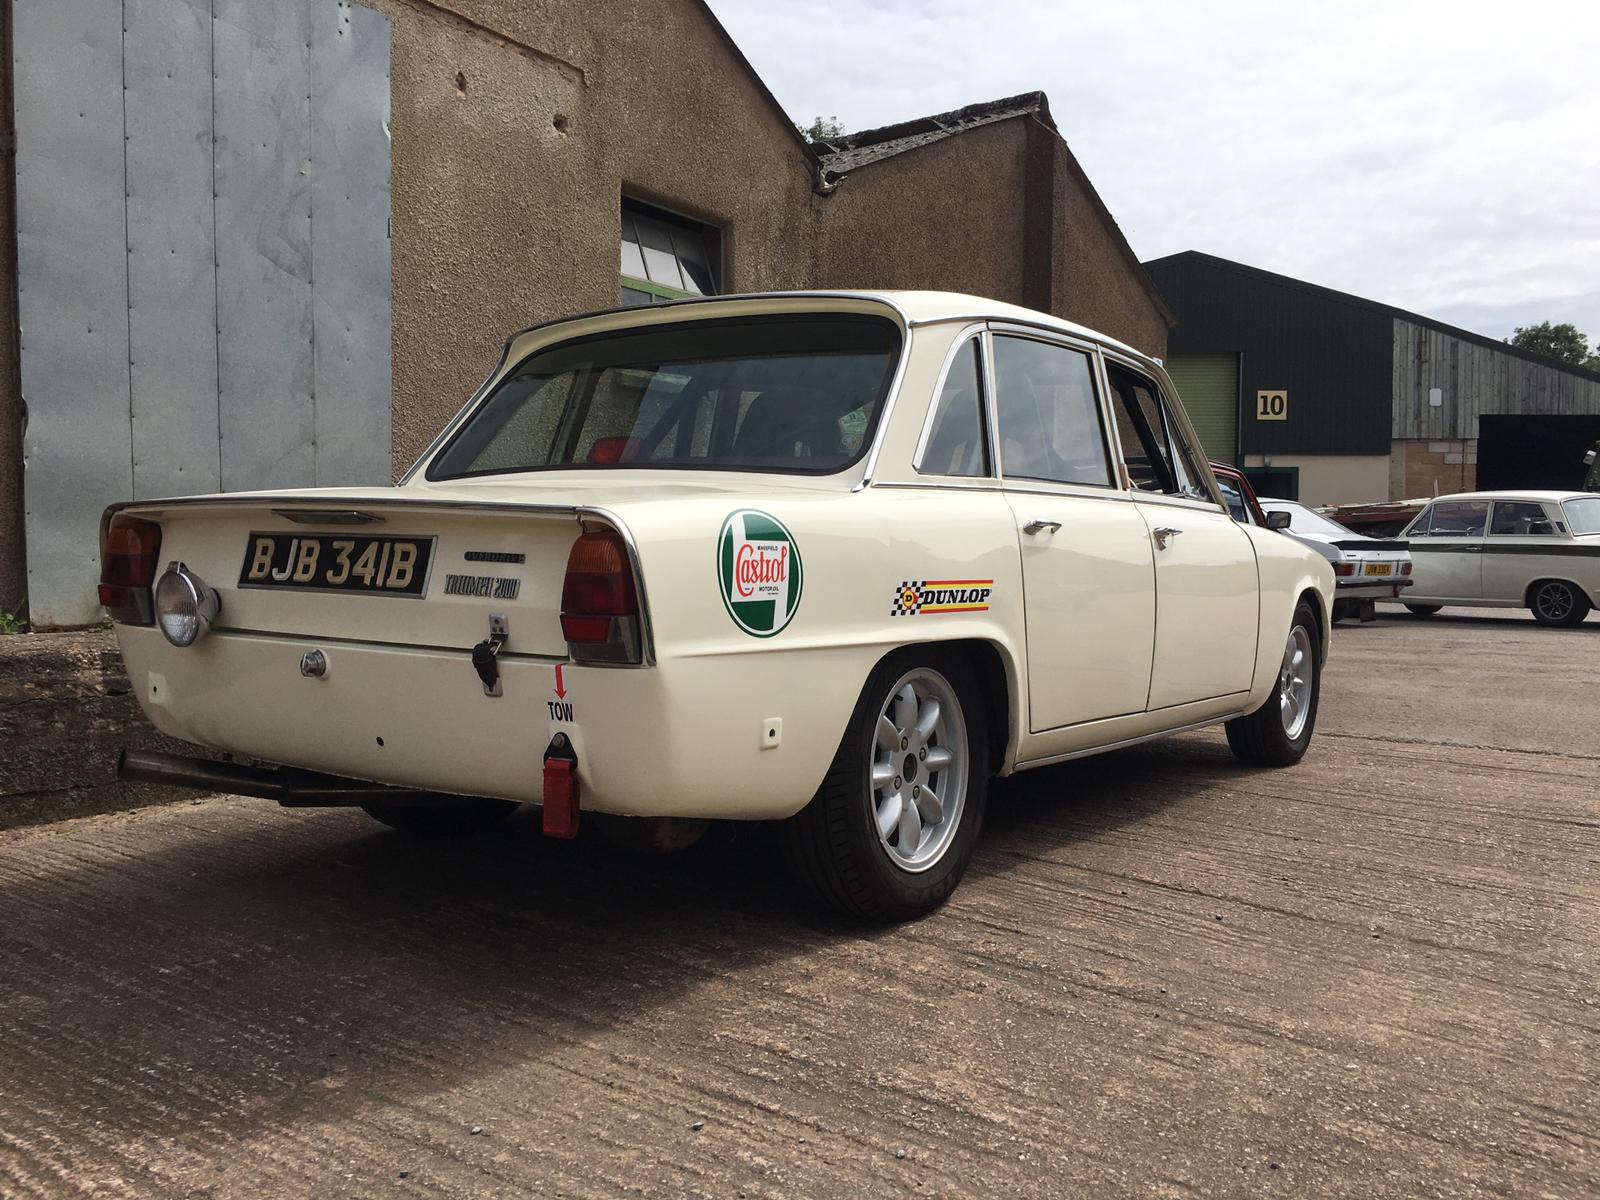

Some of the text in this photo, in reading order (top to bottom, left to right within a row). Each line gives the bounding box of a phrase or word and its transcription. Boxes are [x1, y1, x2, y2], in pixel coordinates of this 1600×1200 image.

[1260, 395, 1284, 415] 10
[248, 538, 417, 588] BJB 341B
[735, 543, 788, 597] Castrol
[444, 574, 520, 600] TRIUMPH 2000
[921, 589, 990, 605] DUNLOP
[547, 702, 573, 722] TOW
